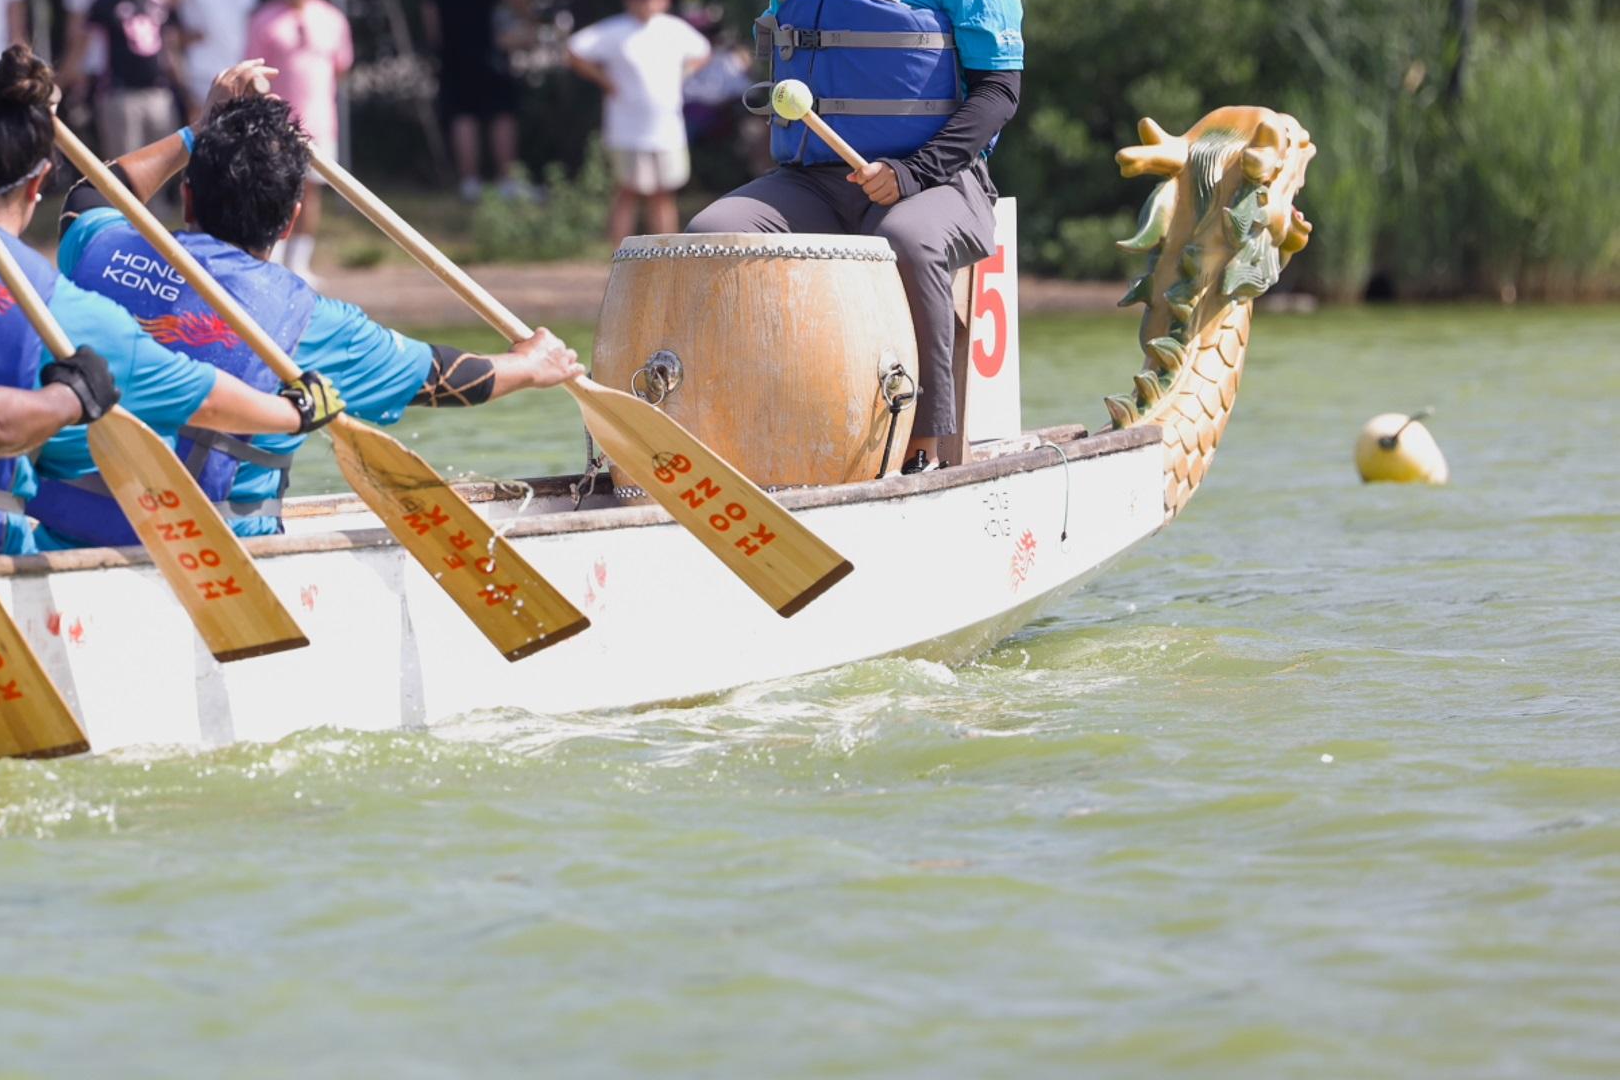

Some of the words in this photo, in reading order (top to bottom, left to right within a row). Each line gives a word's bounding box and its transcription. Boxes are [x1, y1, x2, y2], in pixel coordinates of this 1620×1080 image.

[102, 265, 180, 302] KONG
[111, 249, 187, 285] HONG
[972, 244, 1007, 378] 5
[158, 489, 244, 596] KONG
[653, 465, 761, 557] HONG
[667, 453, 777, 546] KONG
[138, 493, 222, 601] HONG
